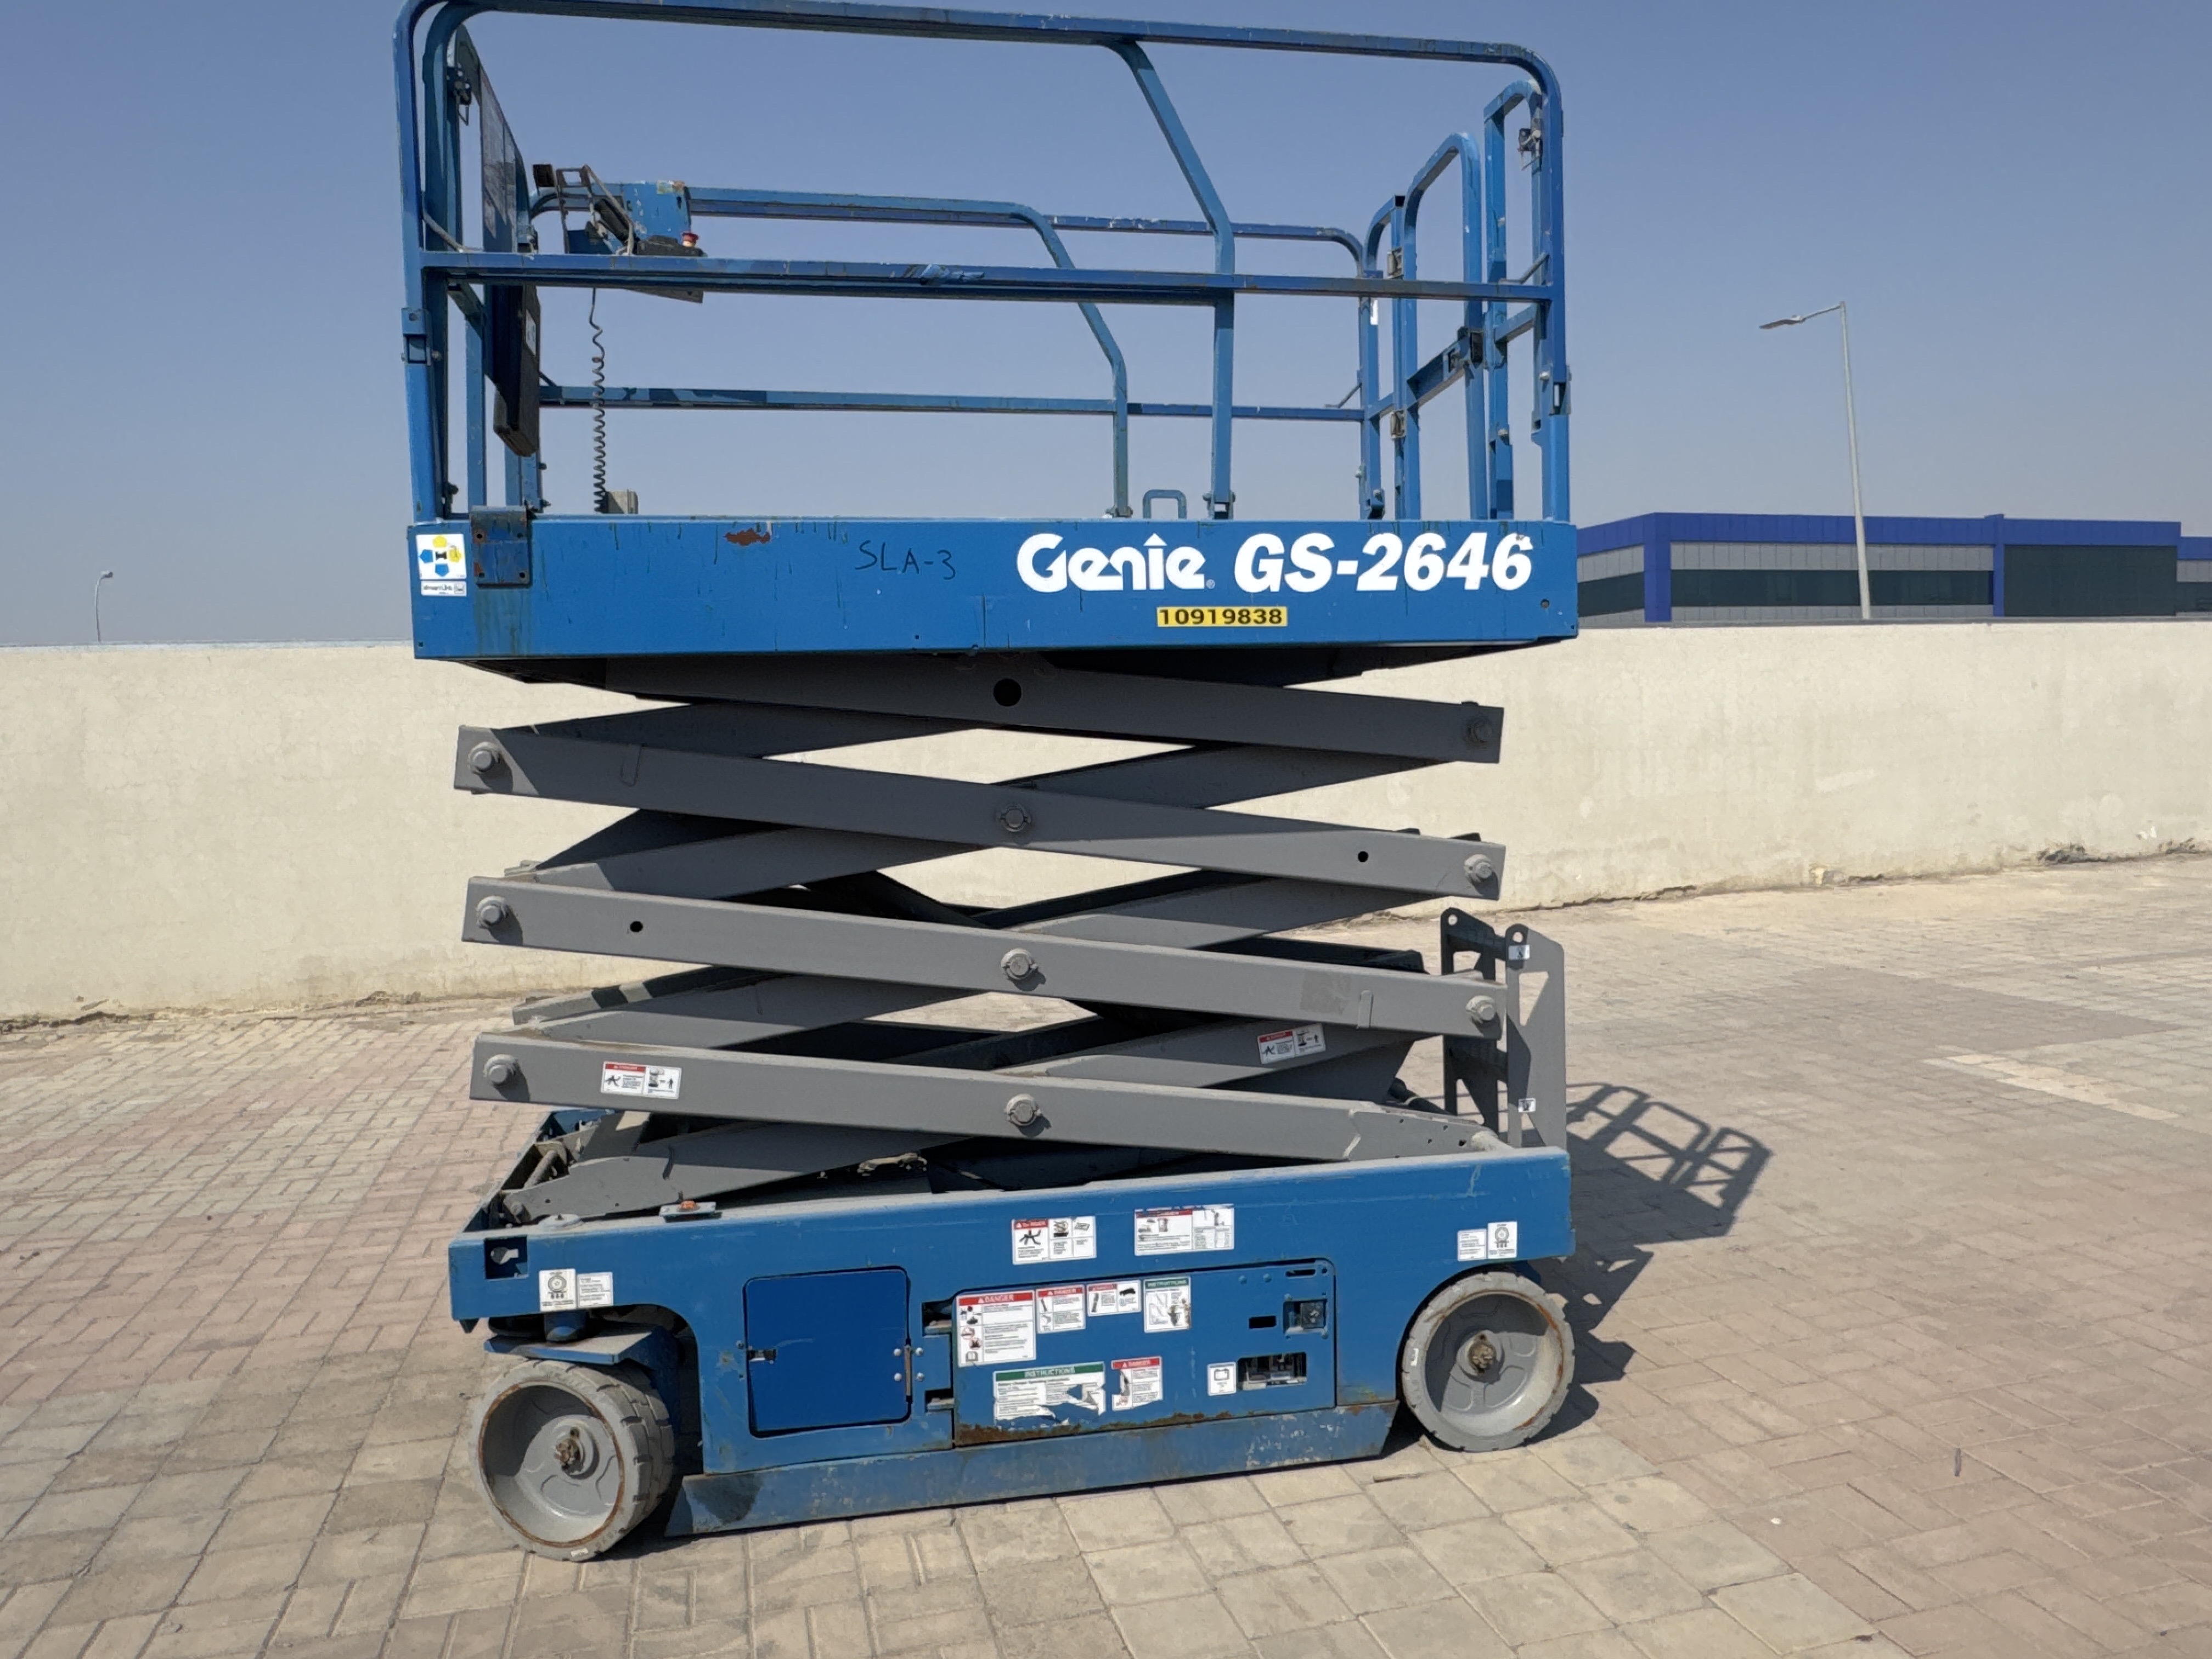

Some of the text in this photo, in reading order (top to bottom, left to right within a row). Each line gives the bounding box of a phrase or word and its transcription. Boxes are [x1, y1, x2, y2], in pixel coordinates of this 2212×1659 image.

[855, 540, 956, 580] SLA-3
[1017, 532, 1534, 593] Genie GS-2646
[1159, 608, 1283, 625] 10919838
[984, 1293, 1015, 1304] DANGER
